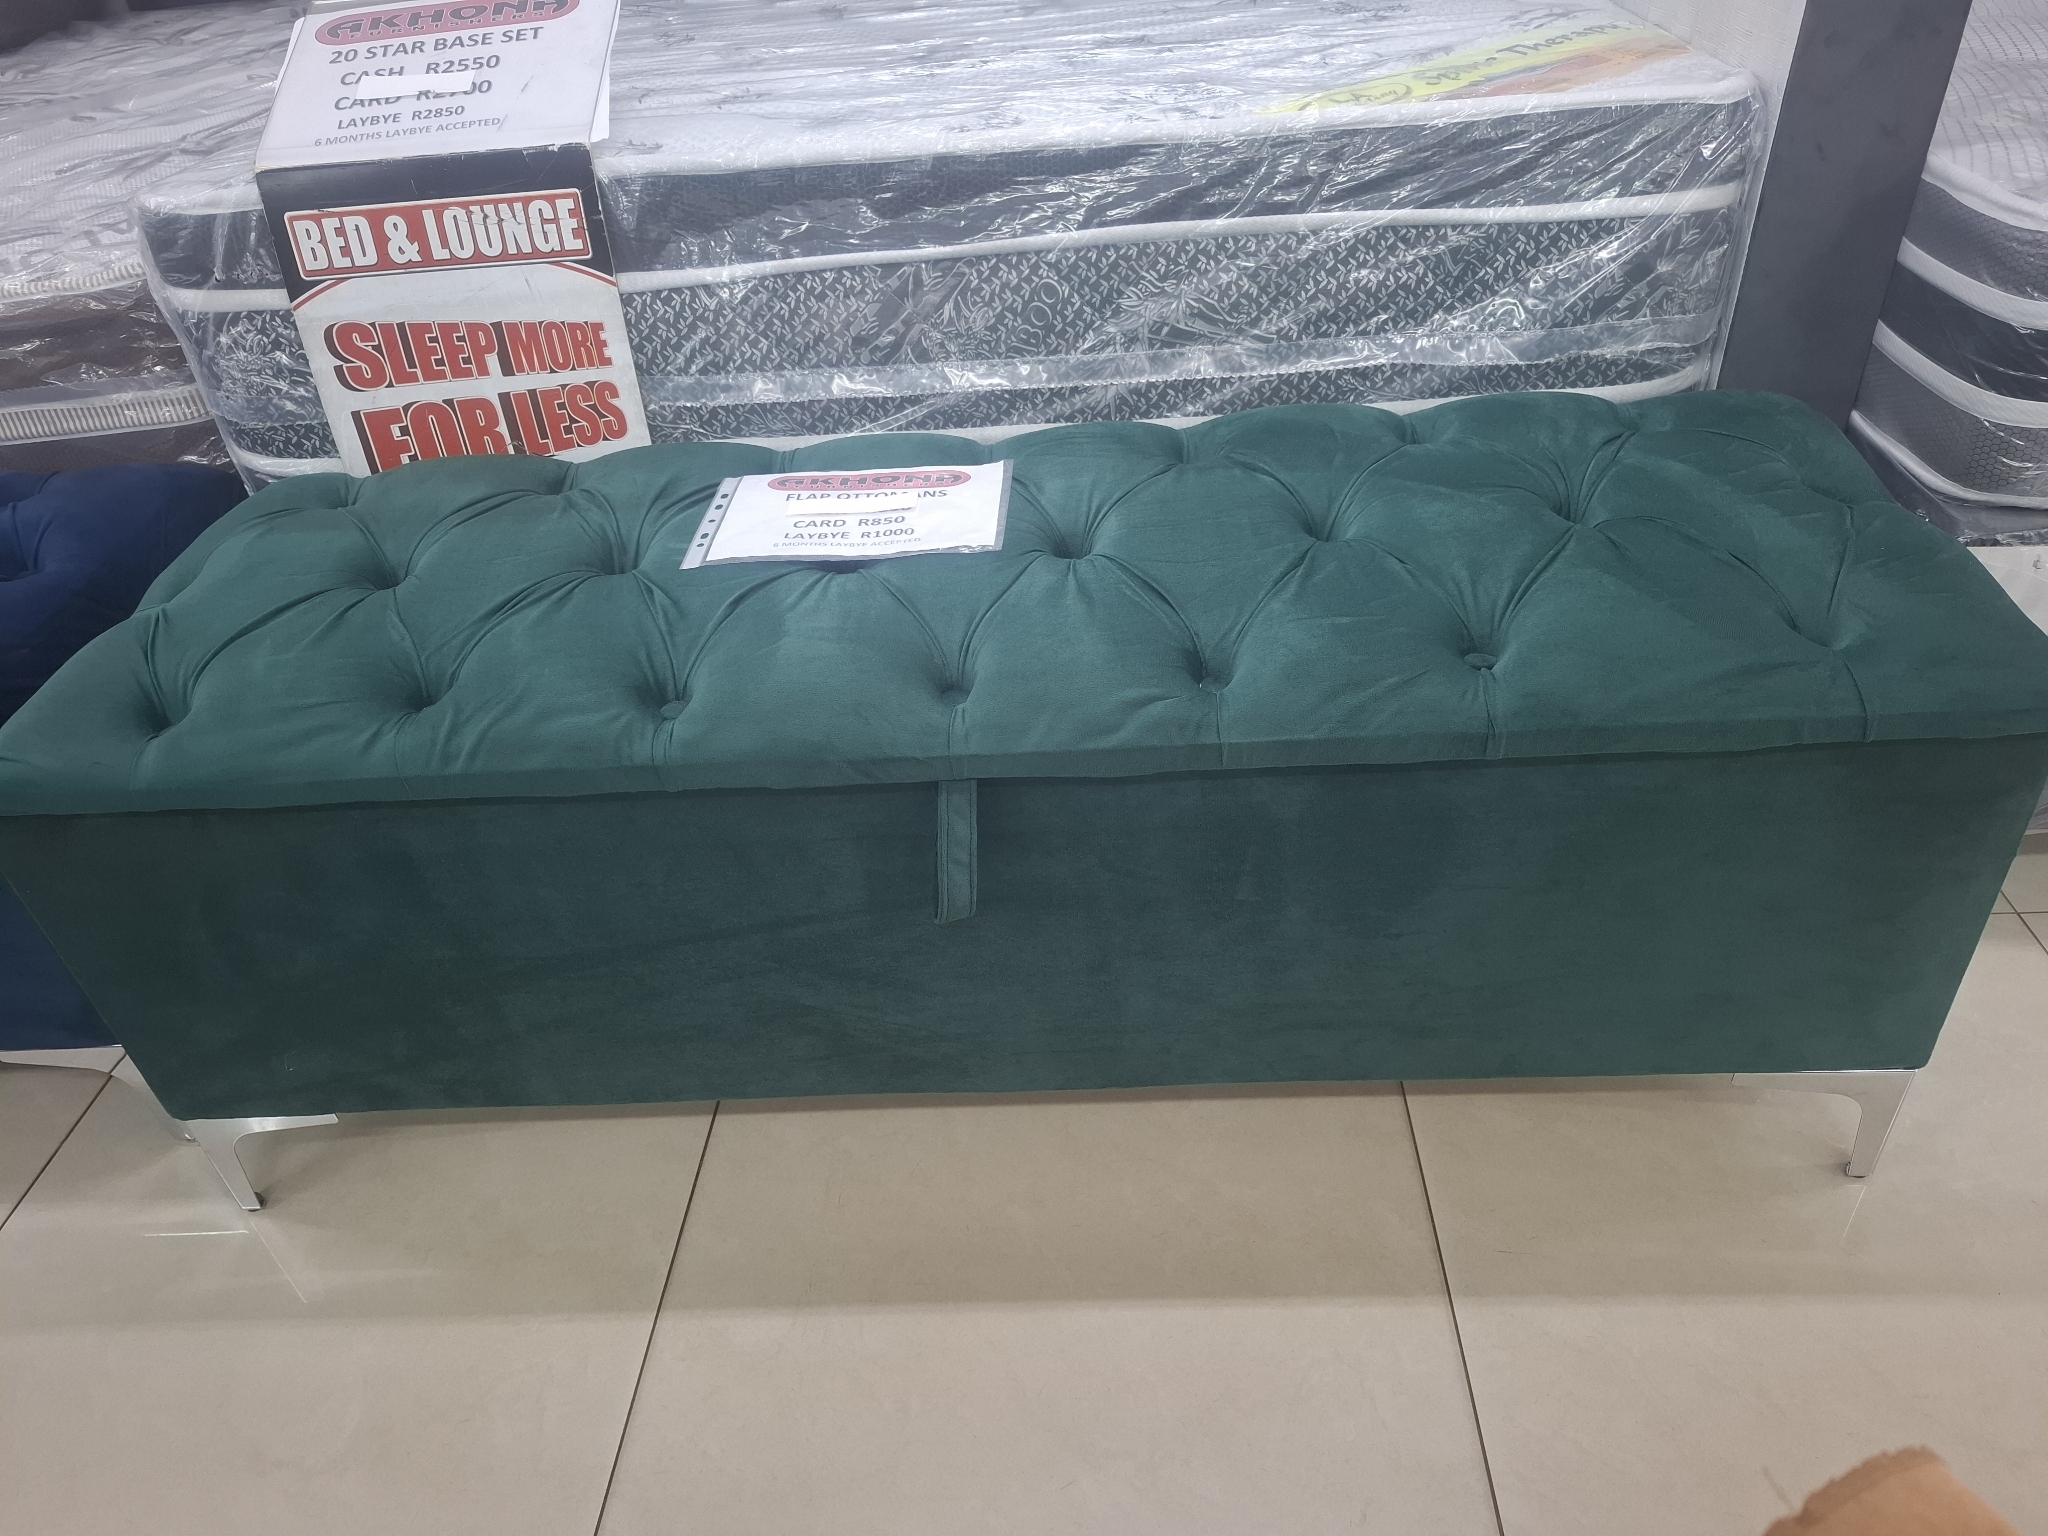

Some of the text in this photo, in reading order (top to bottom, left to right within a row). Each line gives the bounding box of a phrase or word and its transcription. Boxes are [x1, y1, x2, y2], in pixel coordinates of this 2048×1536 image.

[325, 0, 570, 38] AKHONA
[349, 10, 545, 39] FURNISHERS
[328, 26, 544, 64] 20 STAR BASE SET
[1495, 22, 1634, 56] Therapy
[340, 54, 501, 86] CASH R2550
[334, 95, 402, 111] CARD
[337, 105, 465, 130] LAYBYE R2850
[314, 117, 500, 147] 6 MONTHS LAYBYE ACCEPTED
[293, 197, 584, 272] BED & LOUNGE
[323, 320, 615, 392] SLEEP MORE
[350, 380, 629, 475] FOR LESS
[777, 473, 963, 488] AKHONA
[786, 493, 831, 502] FLAP
[784, 527, 915, 540] LAYBYE R1000
[793, 515, 906, 529] CARD R850
[870, 537, 921, 546] ACCEPTED
